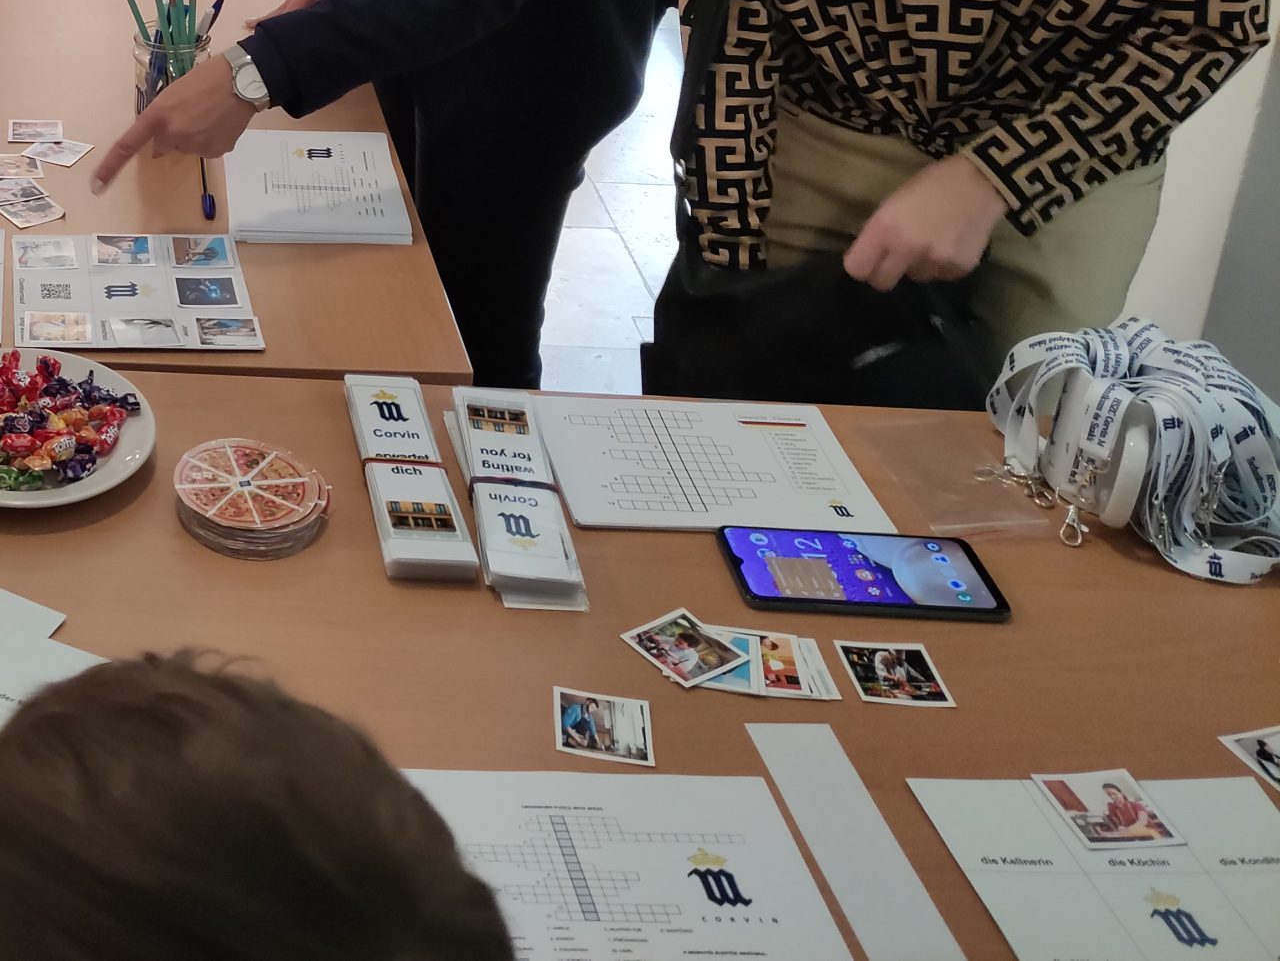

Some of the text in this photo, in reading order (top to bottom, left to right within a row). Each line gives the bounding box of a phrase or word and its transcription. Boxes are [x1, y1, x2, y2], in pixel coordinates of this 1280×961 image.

[373, 427, 420, 440] Corvin
[480, 447, 532, 462] for you
[391, 465, 423, 476] dich
[482, 459, 535, 475] waiting
[488, 492, 539, 508] Corvin
[981, 856, 1054, 867] die Kellnerin
[1108, 855, 1171, 868] die Köchin
[1219, 857, 1238, 867] die
